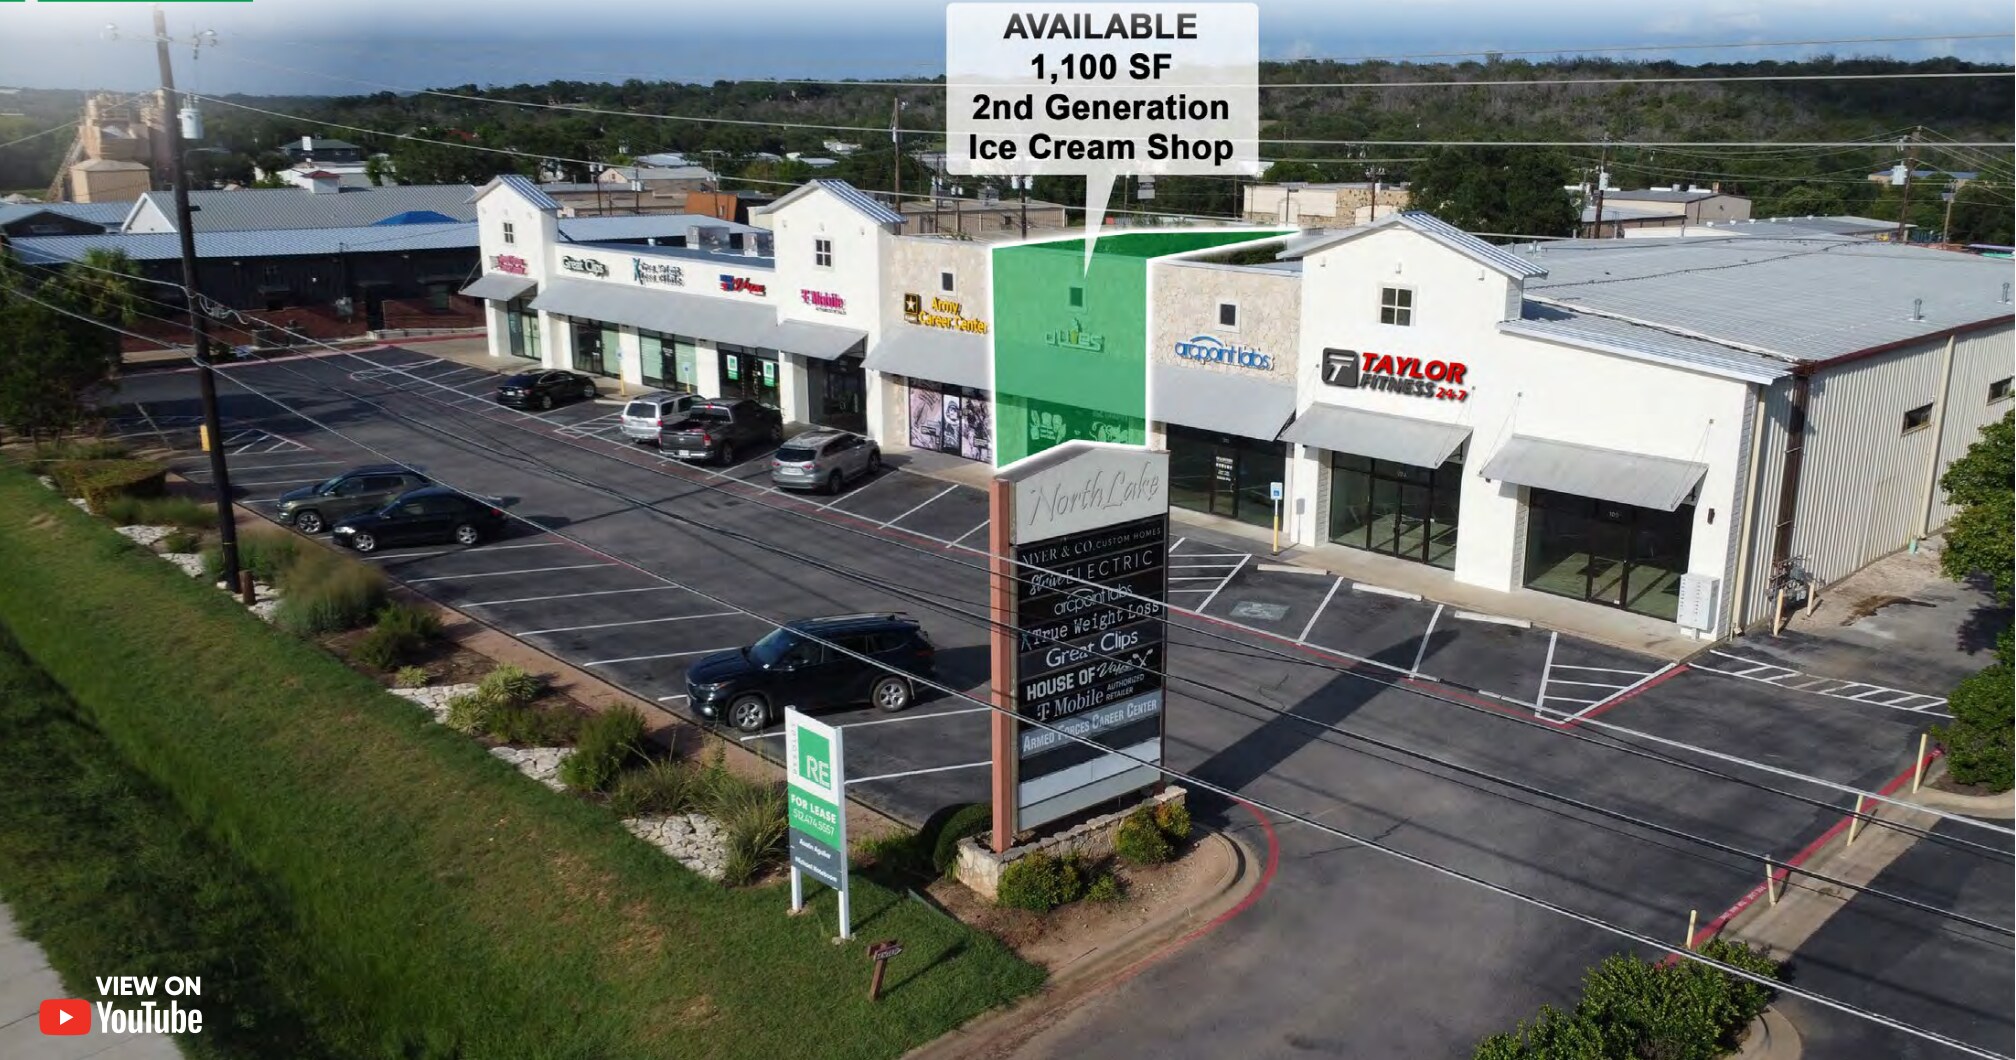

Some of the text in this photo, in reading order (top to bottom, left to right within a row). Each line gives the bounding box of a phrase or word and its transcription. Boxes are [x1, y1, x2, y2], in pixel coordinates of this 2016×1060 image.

[931, 297, 960, 315] Army
[919, 311, 953, 330] Career
[954, 316, 988, 335] Center
[1238, 345, 1270, 370] labs
[1362, 352, 1466, 384] TAYLOR
[1360, 374, 1467, 401] FITNESS 24-7
[1022, 548, 1058, 565] MYER
[1061, 545, 1070, 558] &
[1096, 534, 1130, 549] CUSTOM
[1132, 527, 1162, 541] HOMES
[1066, 550, 1153, 585] ELECTRIC
[1107, 584, 1133, 602] labs
[1032, 602, 1160, 645] True Weight Loss
[1046, 630, 1139, 668] Great Clips
[1026, 672, 1074, 701] HOUSE
[1078, 666, 1096, 684] OF
[1105, 686, 1134, 701] RETAILER
[1106, 673, 1145, 691] AUTHORIZED
[1054, 687, 1104, 718] Mobile
[1023, 698, 1157, 752] ARMED FORCES CAREER CENTER
[806, 755, 831, 788] RE
[790, 793, 837, 825] FOR LEASE
